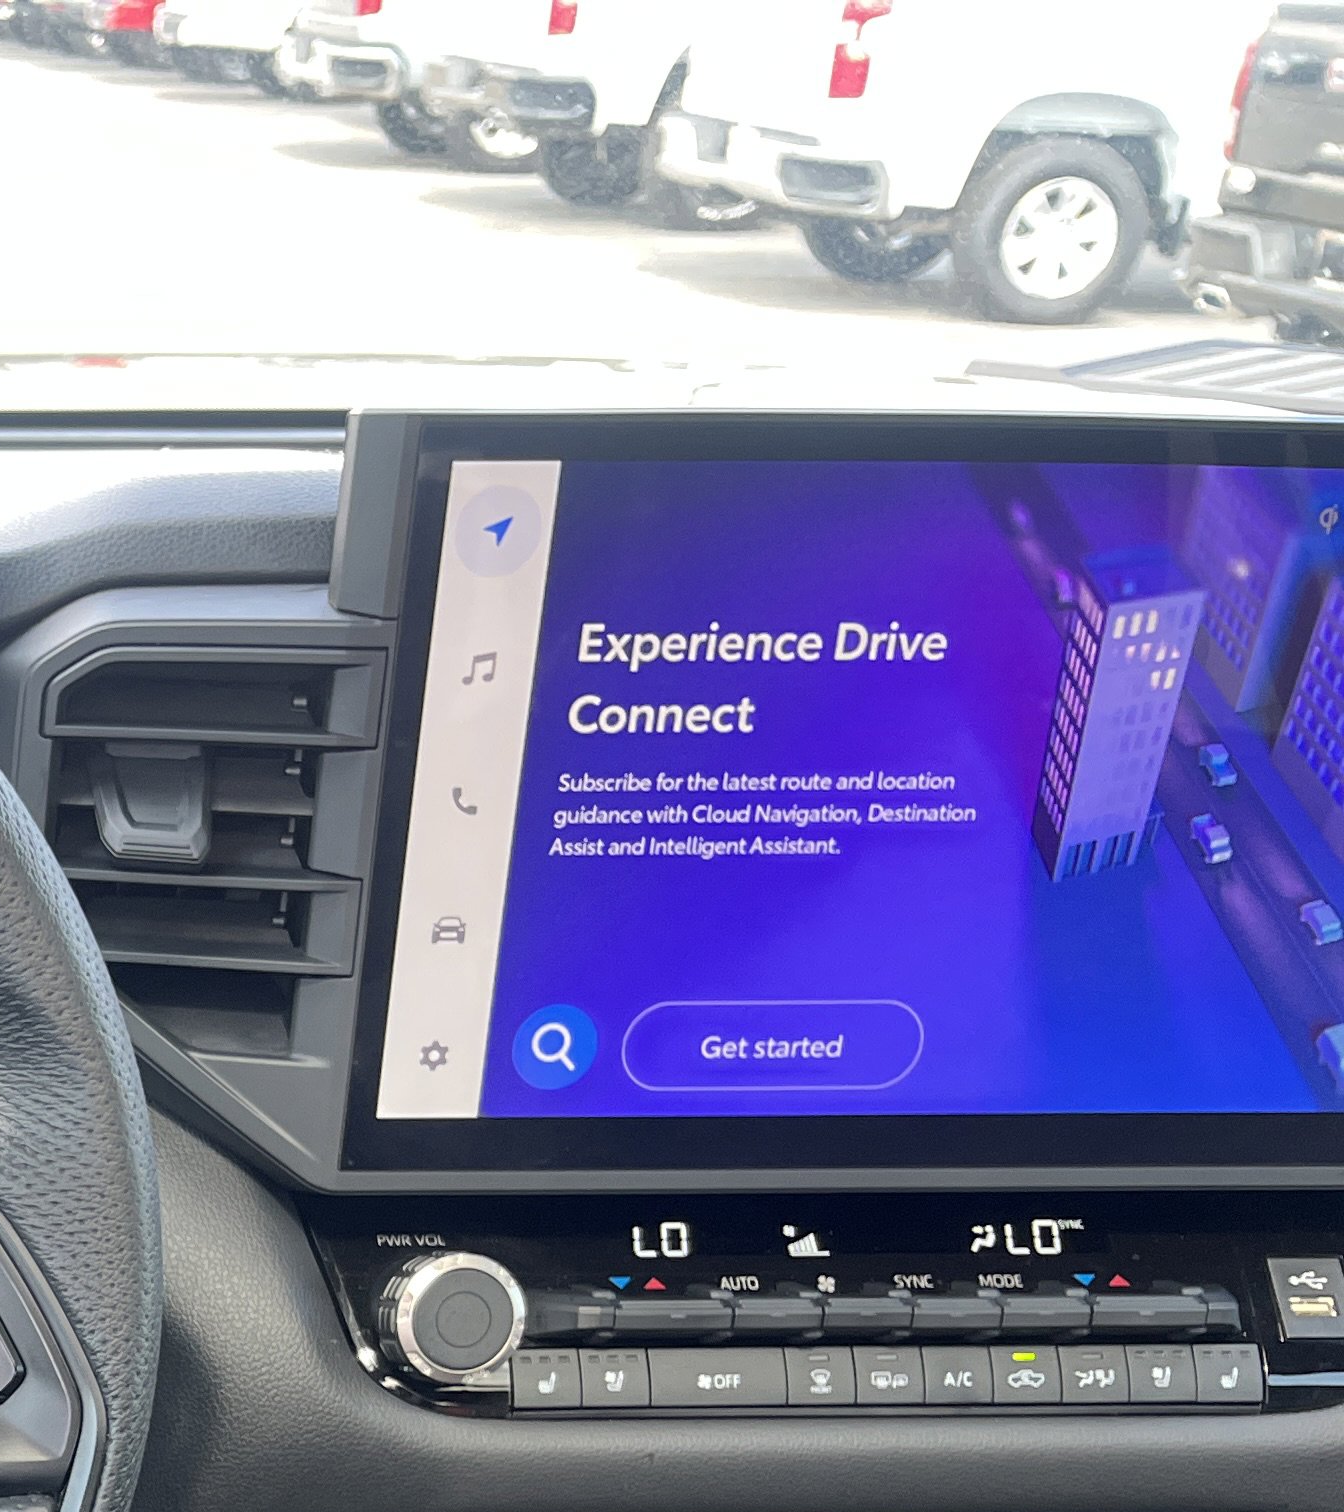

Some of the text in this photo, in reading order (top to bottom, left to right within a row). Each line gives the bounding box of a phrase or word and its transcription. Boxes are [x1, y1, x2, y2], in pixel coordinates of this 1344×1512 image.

[578, 621, 948, 673] Experience Drive
[569, 694, 756, 734] Connect
[558, 772, 956, 792] Subscribe for the latest route and location
[553, 803, 977, 829] guidance with Cloud Navigation, Destination
[549, 836, 842, 860] Assist and Intelligent Assistant.
[700, 1034, 844, 1060] Get started
[376, 1234, 446, 1248] PWR VOL
[631, 1220, 691, 1259] LO
[1004, 1219, 1063, 1256] LO
[719, 1275, 760, 1292] AUTO
[893, 1273, 934, 1290] SYNC
[977, 1273, 1024, 1289] MODE
[714, 1373, 741, 1389] OFF
[943, 1370, 973, 1388] A/C
